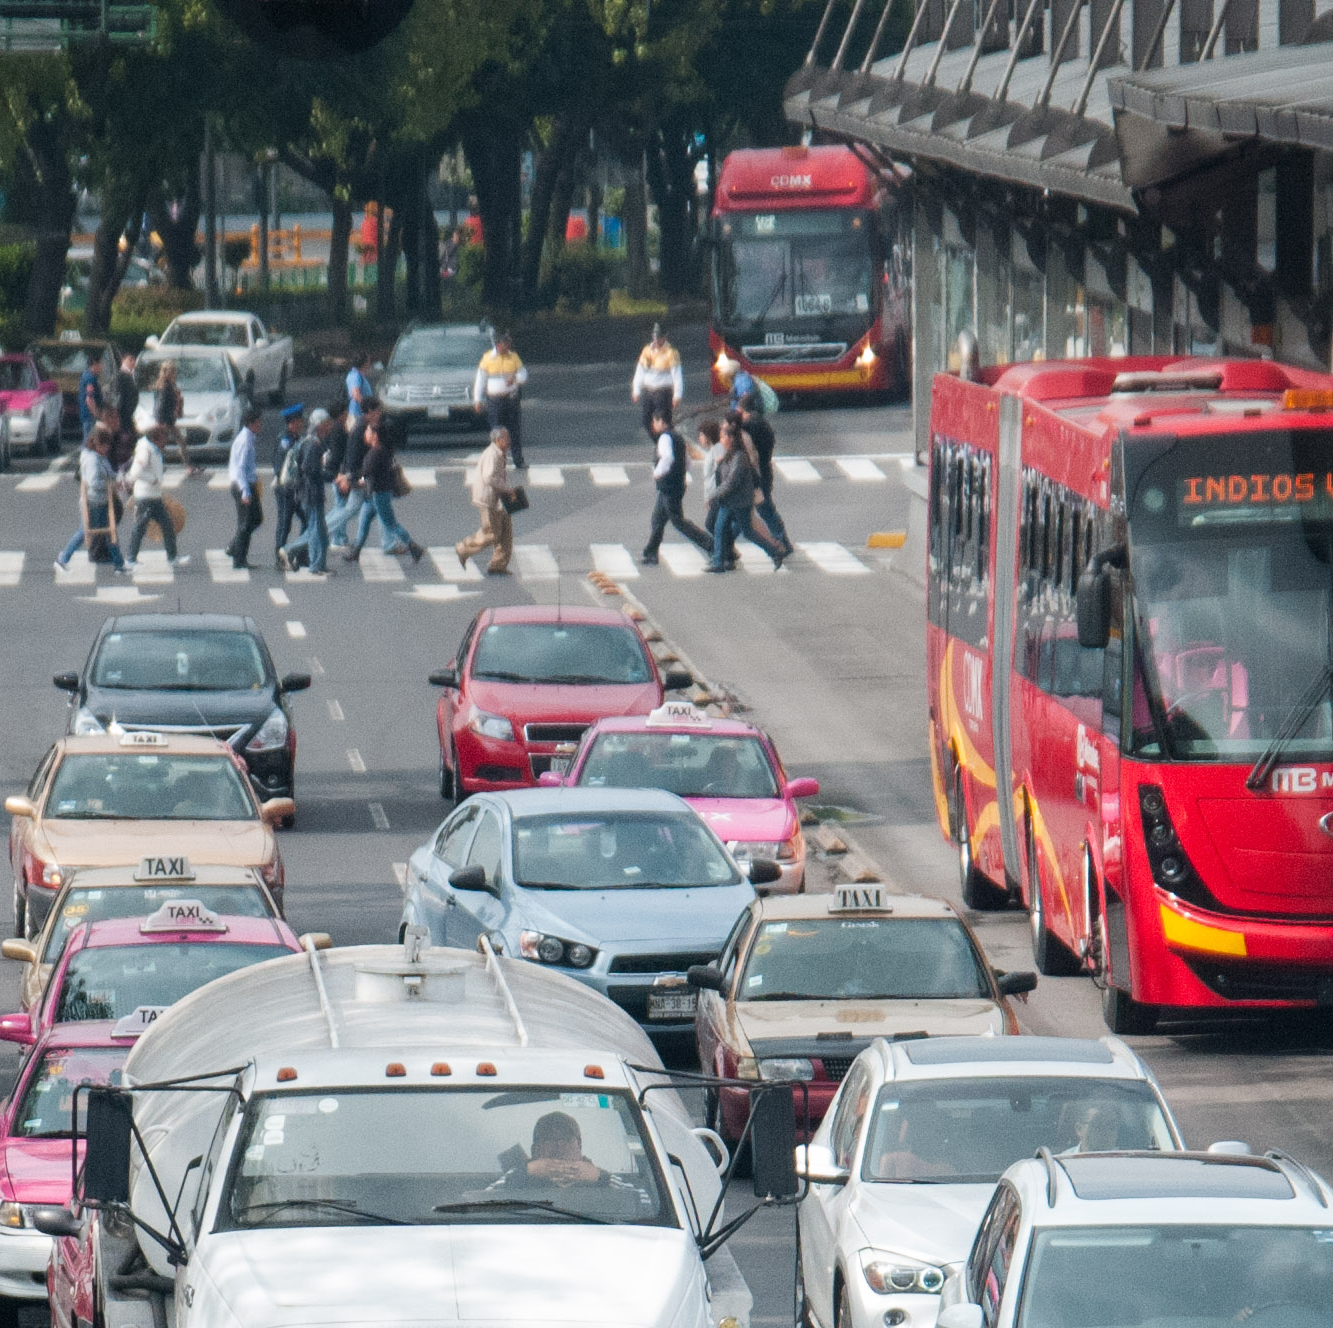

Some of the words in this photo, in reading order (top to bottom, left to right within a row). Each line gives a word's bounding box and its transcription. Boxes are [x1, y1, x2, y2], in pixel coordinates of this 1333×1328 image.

[771, 175, 811, 186] CDMX
[1184, 473, 1314, 503] INDIOS
[667, 706, 691, 716] TAXI
[133, 735, 157, 743] TAXI
[144, 858, 184, 875] TAXI
[838, 889, 881, 908] TAXI
[168, 906, 199, 918] TAXI
